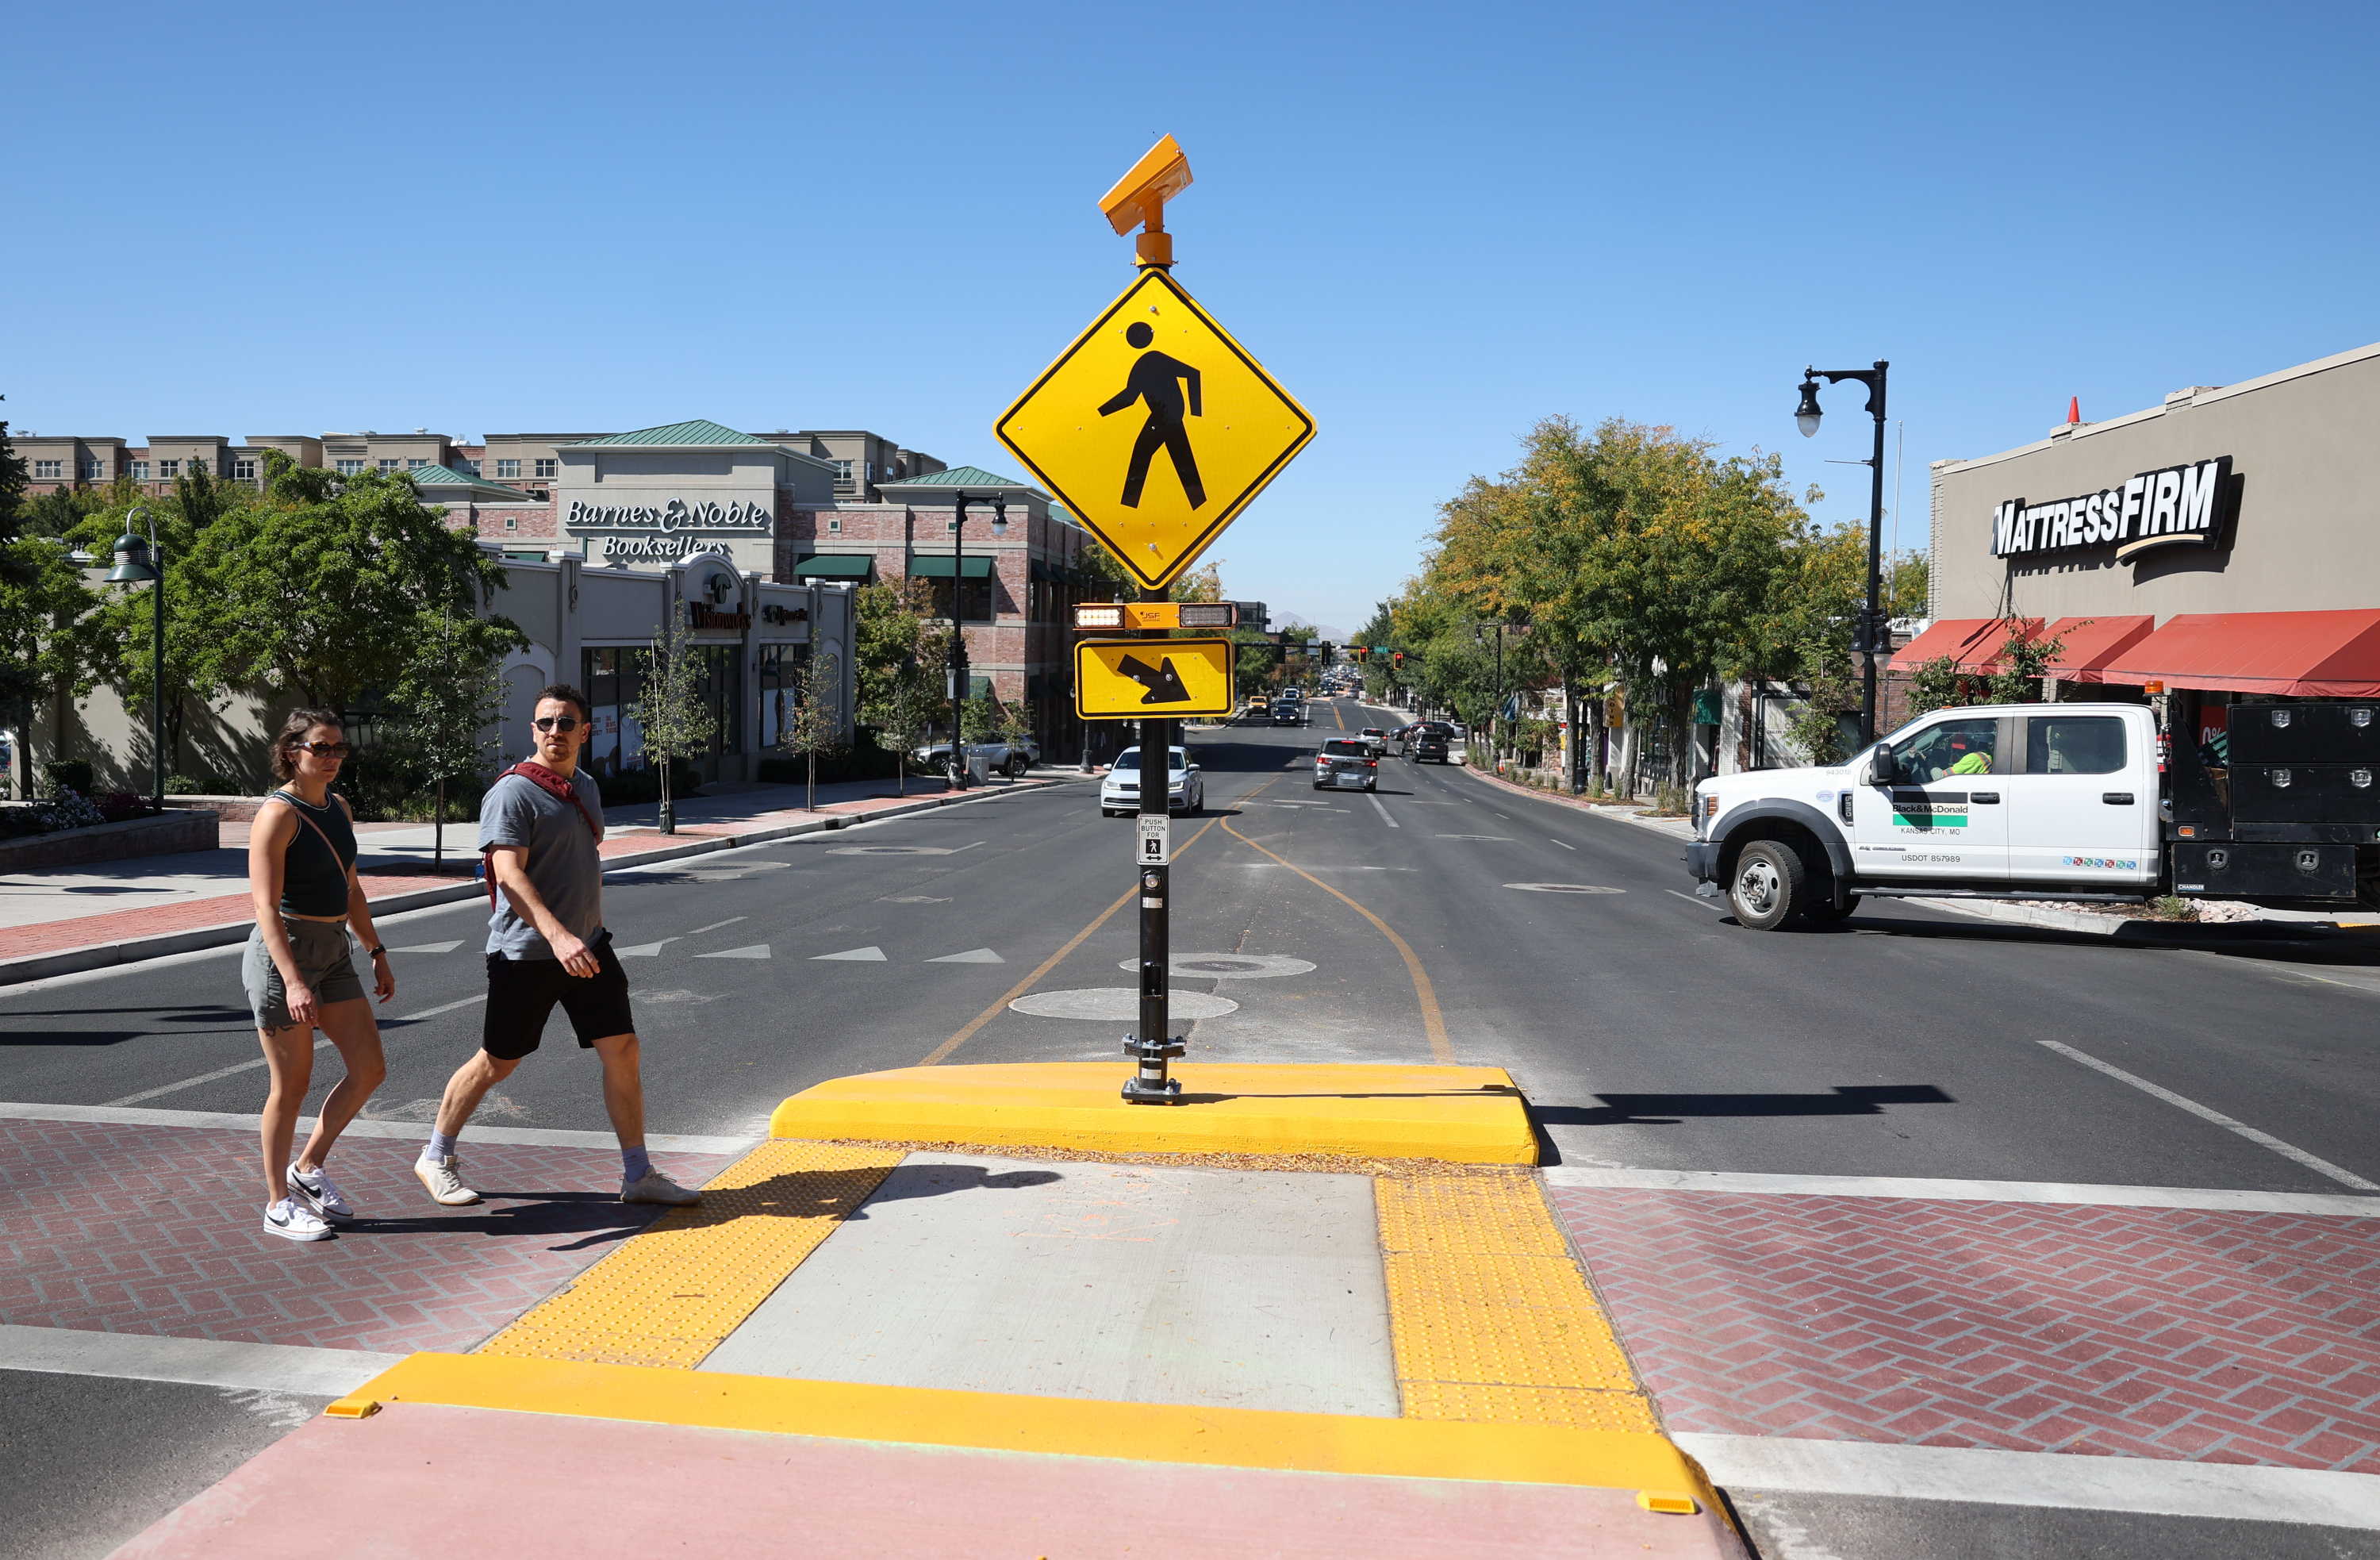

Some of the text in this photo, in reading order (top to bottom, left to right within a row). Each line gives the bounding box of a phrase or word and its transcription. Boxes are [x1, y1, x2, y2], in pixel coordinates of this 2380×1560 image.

[564, 497, 766, 534] Barnes & Noble
[601, 535, 727, 556] Booksellers
[691, 601, 751, 630] Visionworks
[1892, 805, 1968, 814] Black&McDonald
